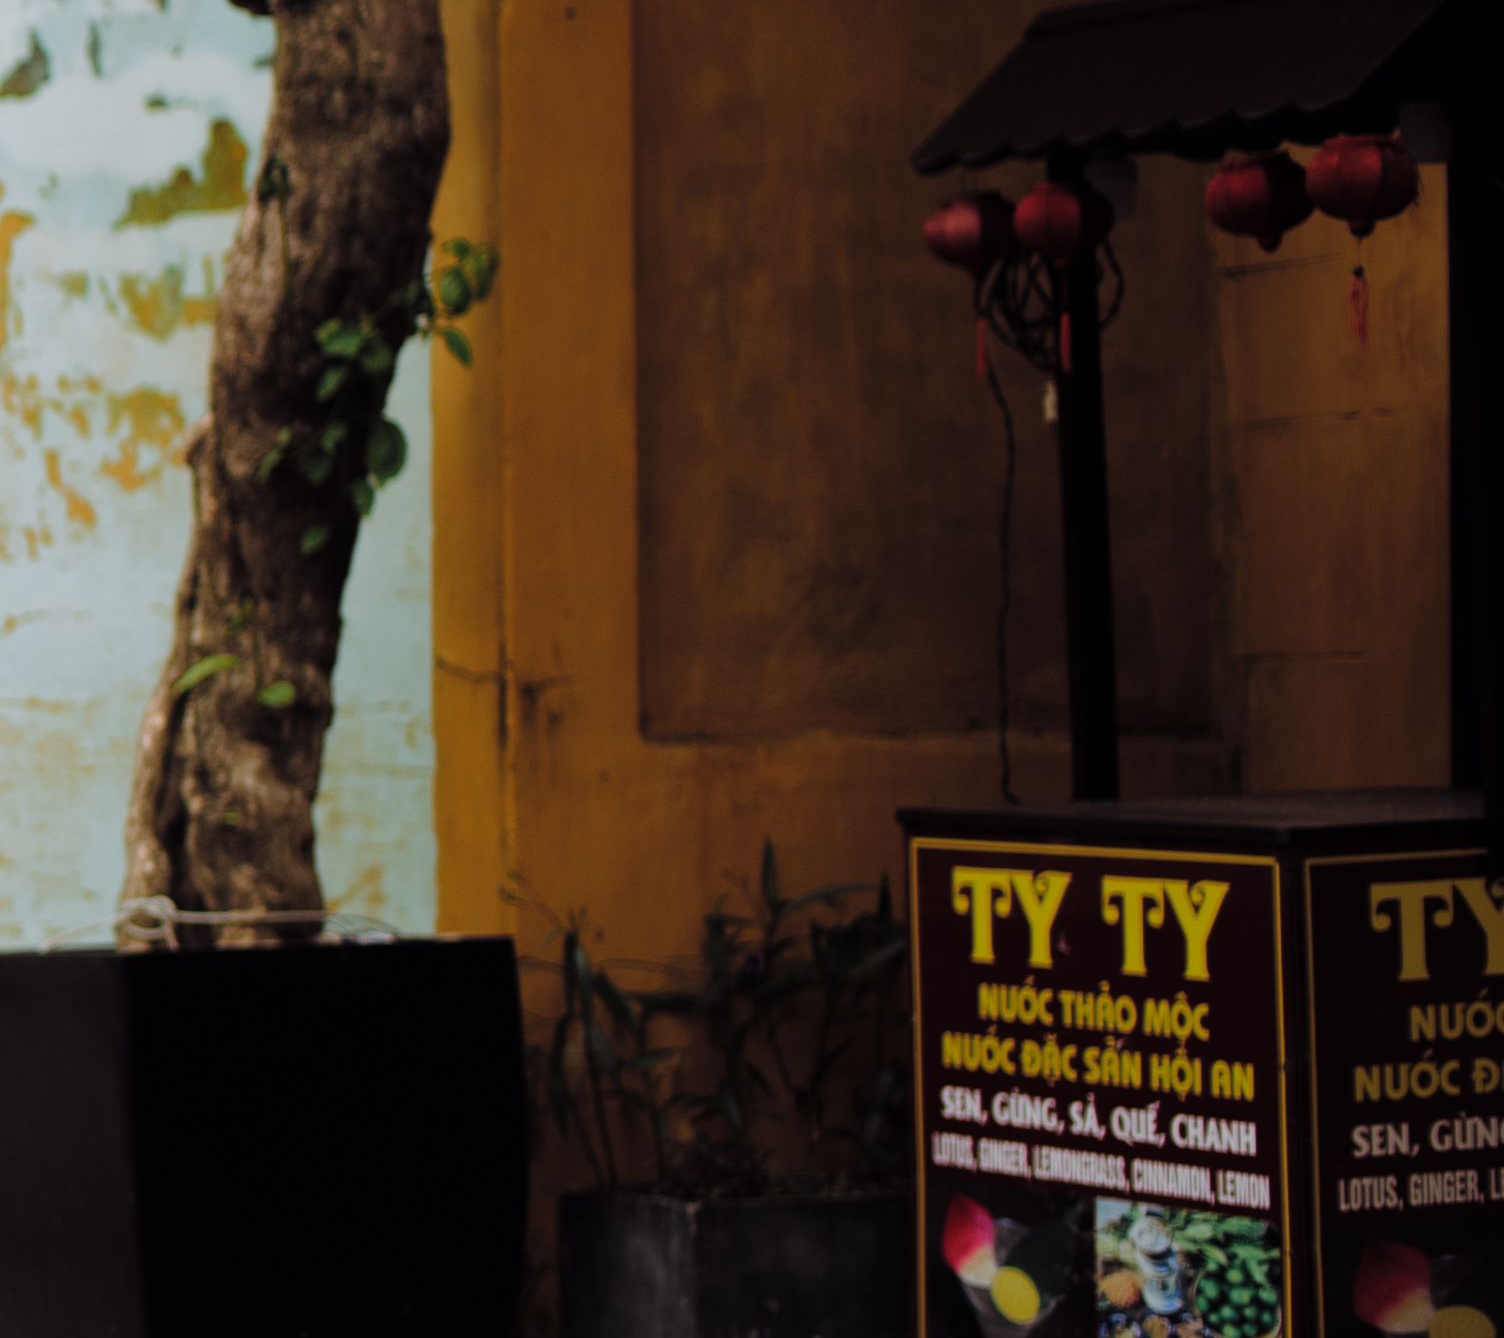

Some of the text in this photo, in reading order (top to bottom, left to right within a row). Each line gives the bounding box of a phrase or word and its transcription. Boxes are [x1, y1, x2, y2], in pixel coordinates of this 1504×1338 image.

[952, 866, 1229, 981] TY TY
[1210, 1061, 1255, 1103] AN
[939, 1084, 989, 1125] SEN,
[1170, 1113, 1257, 1157] CHANH
[1350, 1110, 1504, 1159] SEN, GỪN
[1131, 1157, 1216, 1205] CINNAMON,
[1216, 1168, 1272, 1211] LEMON
[1337, 1174, 1405, 1214] LOTUS,
[1408, 1168, 1485, 1206] GINGER,
